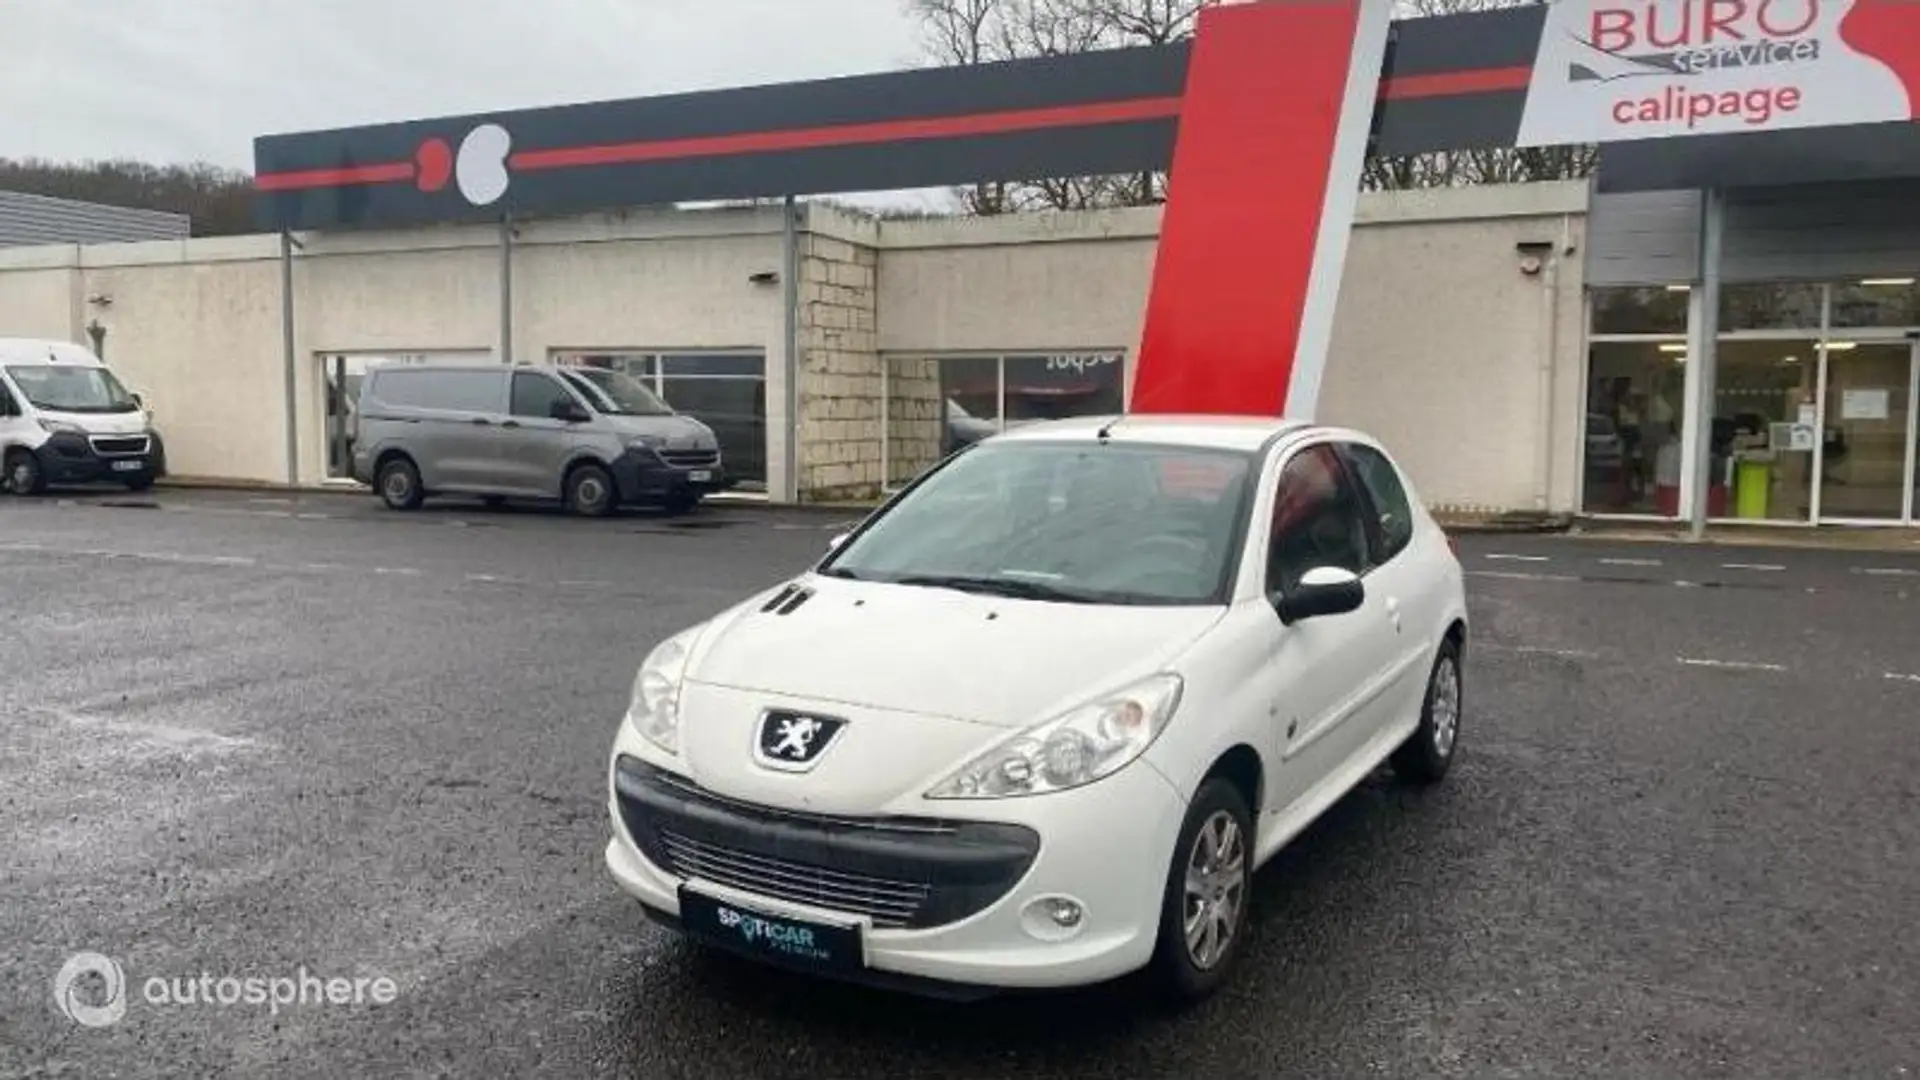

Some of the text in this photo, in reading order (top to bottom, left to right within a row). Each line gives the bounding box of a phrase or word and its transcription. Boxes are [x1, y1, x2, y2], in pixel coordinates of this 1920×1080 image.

[1591, 0, 1819, 52] BURO
[1673, 38, 1820, 73] service
[1612, 85, 1801, 127] calipage
